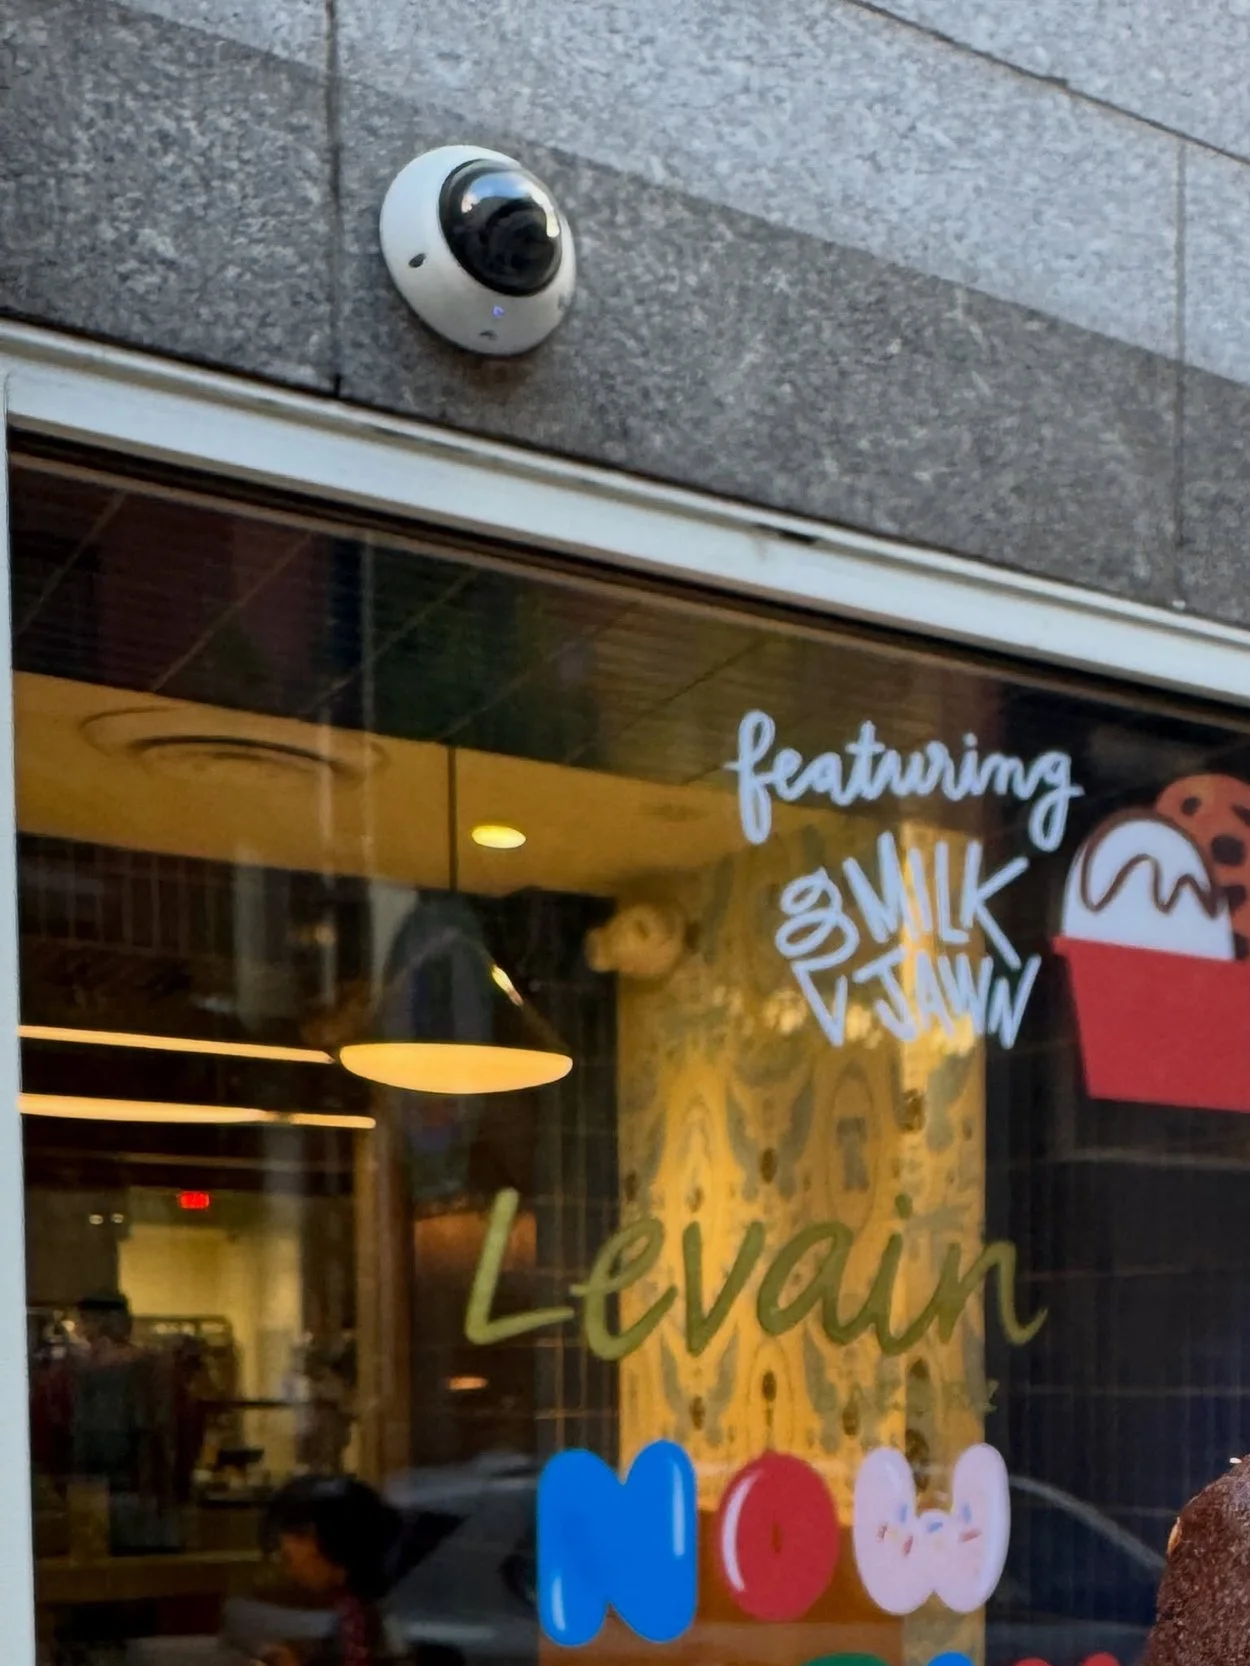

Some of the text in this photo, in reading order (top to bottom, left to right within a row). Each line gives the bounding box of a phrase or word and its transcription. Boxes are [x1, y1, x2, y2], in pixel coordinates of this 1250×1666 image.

[724, 710, 1084, 851] featuring
[842, 831, 1029, 968] MILK
[852, 949, 1041, 1049] JAWN
[464, 1187, 1047, 1361] Levain
[537, 1439, 1010, 1647] NOW
